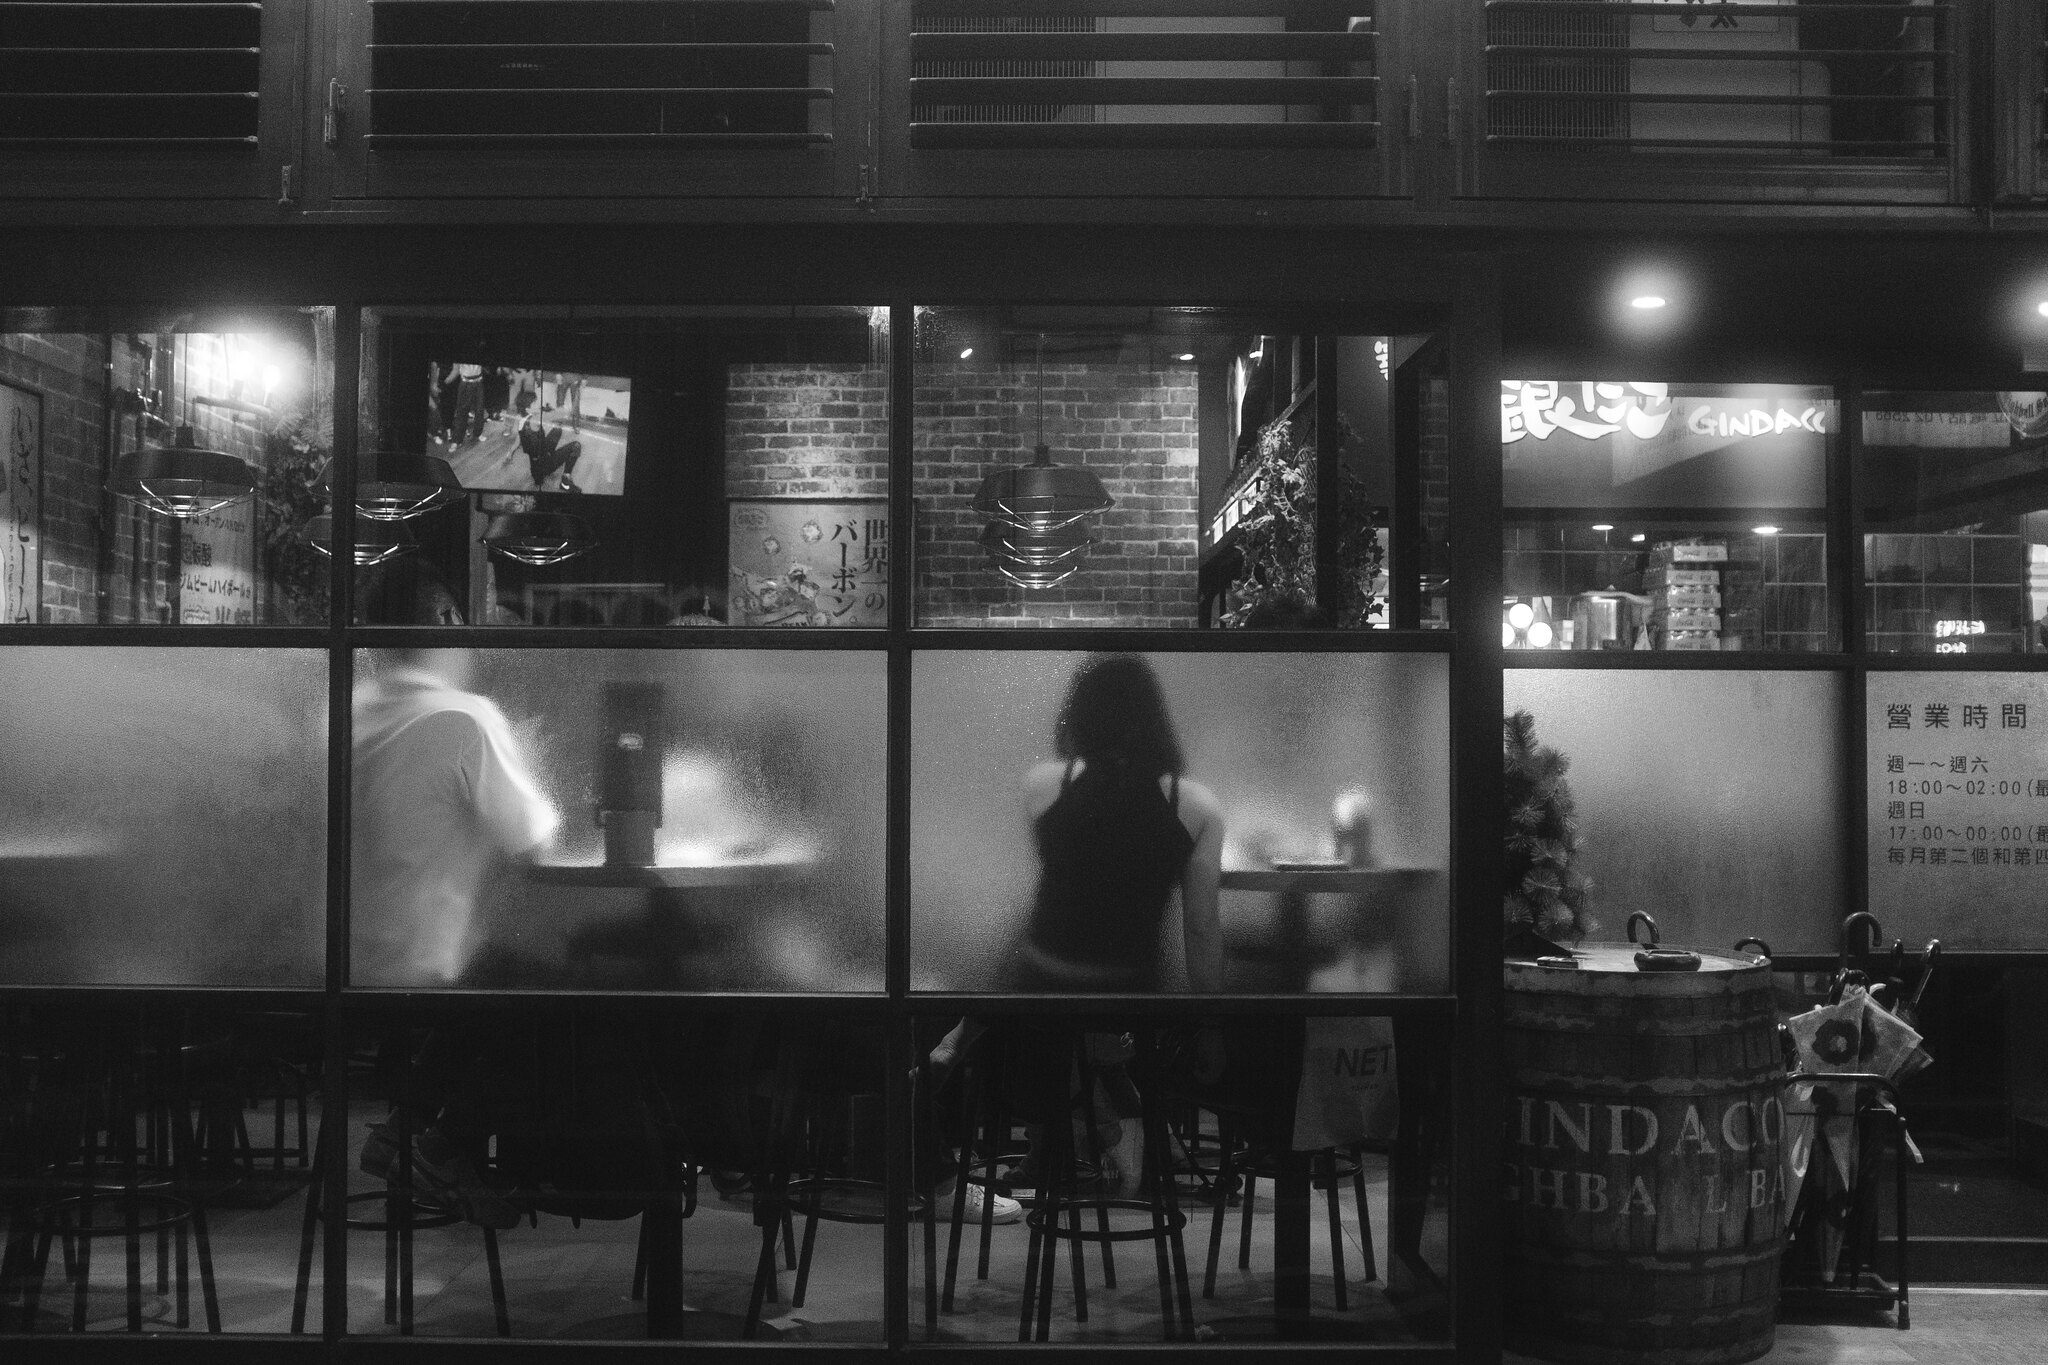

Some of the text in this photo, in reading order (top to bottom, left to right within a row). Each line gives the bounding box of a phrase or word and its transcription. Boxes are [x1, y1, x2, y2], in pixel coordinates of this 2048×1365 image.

[1887, 703, 2027, 730] 營業時間
[1887, 754, 1989, 774] 週一～週六
[1888, 801, 1925, 819] 週日
